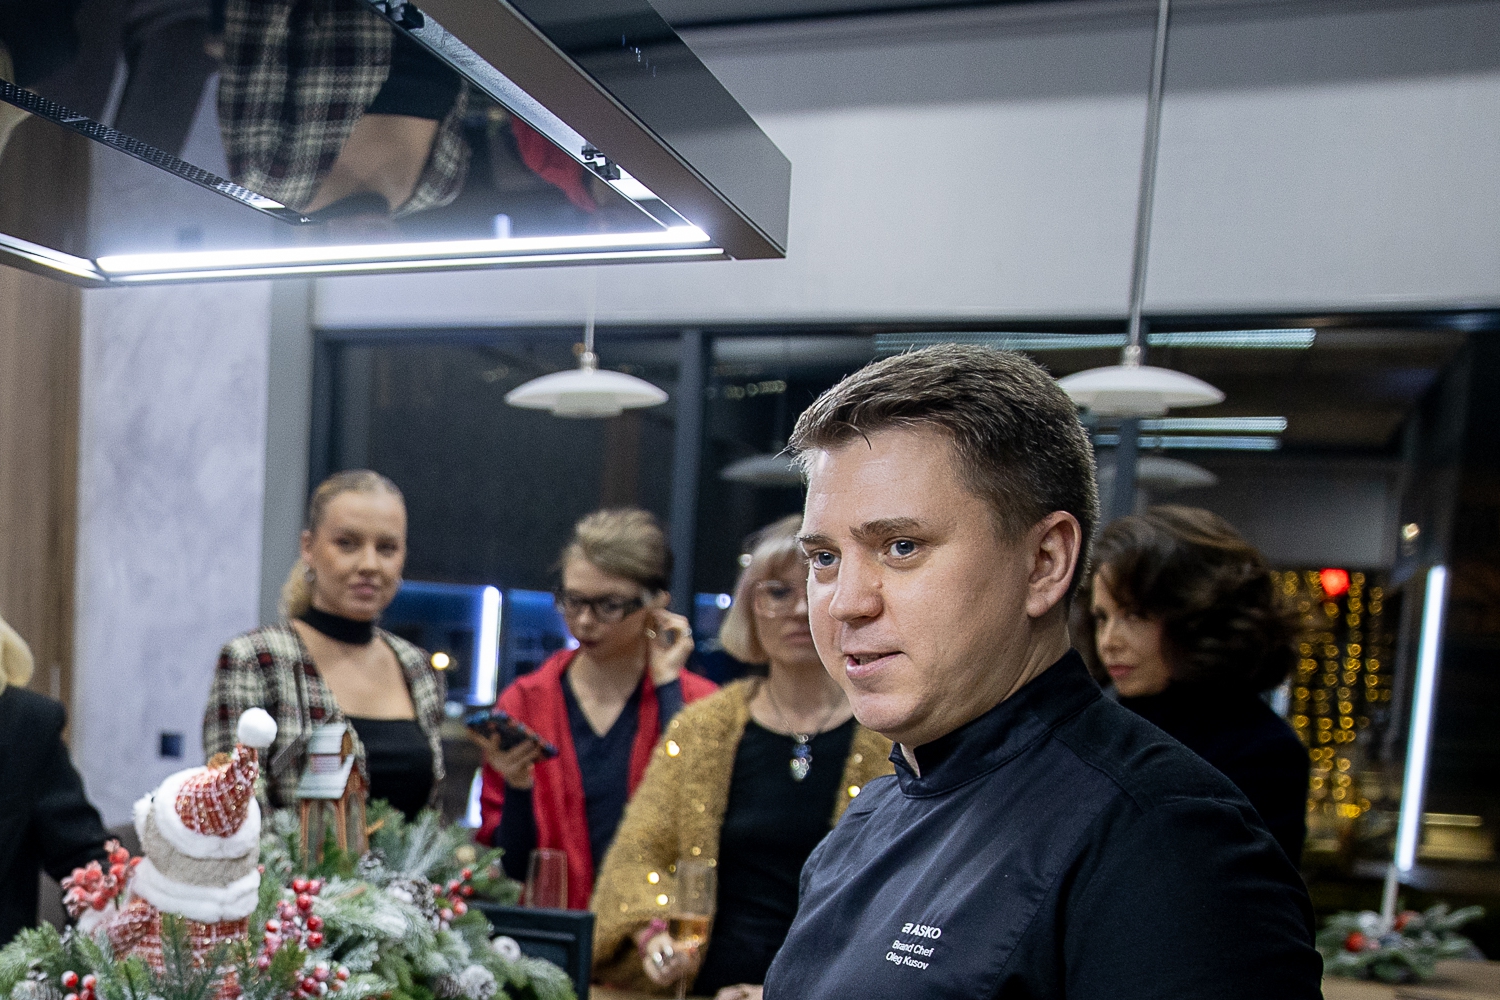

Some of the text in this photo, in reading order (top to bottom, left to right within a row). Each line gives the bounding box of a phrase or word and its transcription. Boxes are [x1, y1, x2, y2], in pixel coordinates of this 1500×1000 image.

[910, 924, 942, 940] ASKO
[892, 940, 935, 957] Brand Chef
[885, 951, 930, 970] Oleg Kusov
